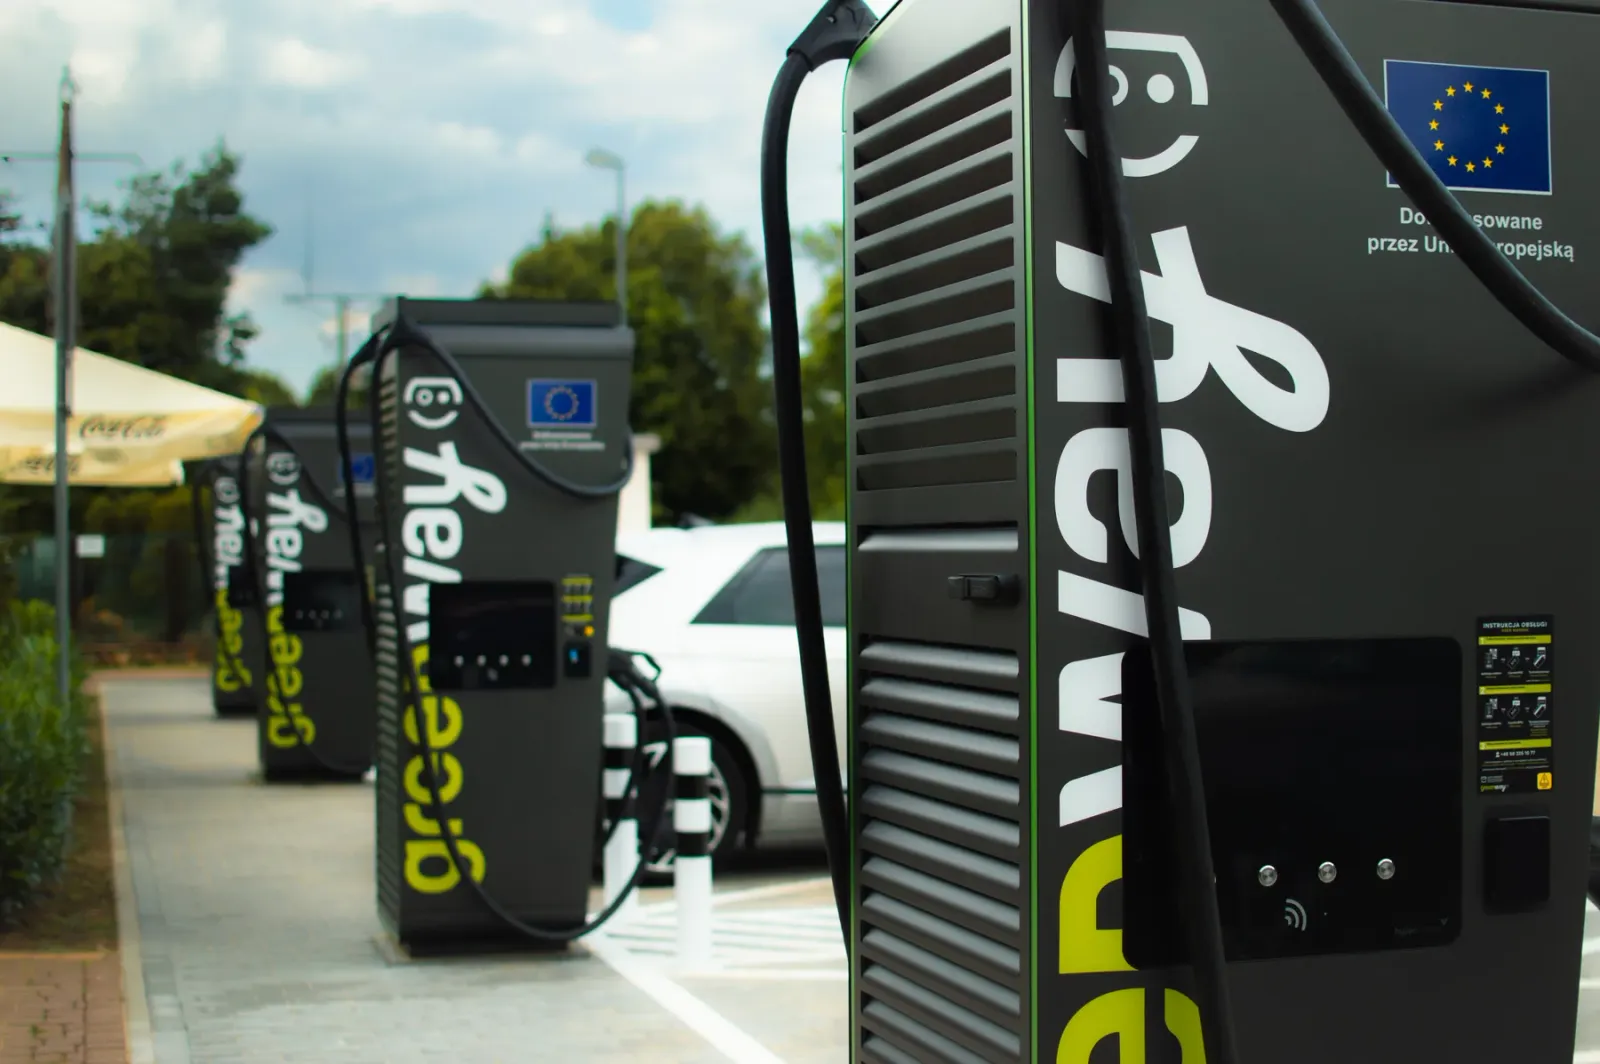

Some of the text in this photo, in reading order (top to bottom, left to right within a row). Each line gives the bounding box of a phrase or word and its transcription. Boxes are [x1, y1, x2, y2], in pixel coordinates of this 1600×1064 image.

[1400, 207, 1543, 230] Dosowane
[1367, 236, 1419, 255] przez
[1493, 240, 1575, 263] ropejską
[1482, 621, 1520, 629] INSTRUKCJA
